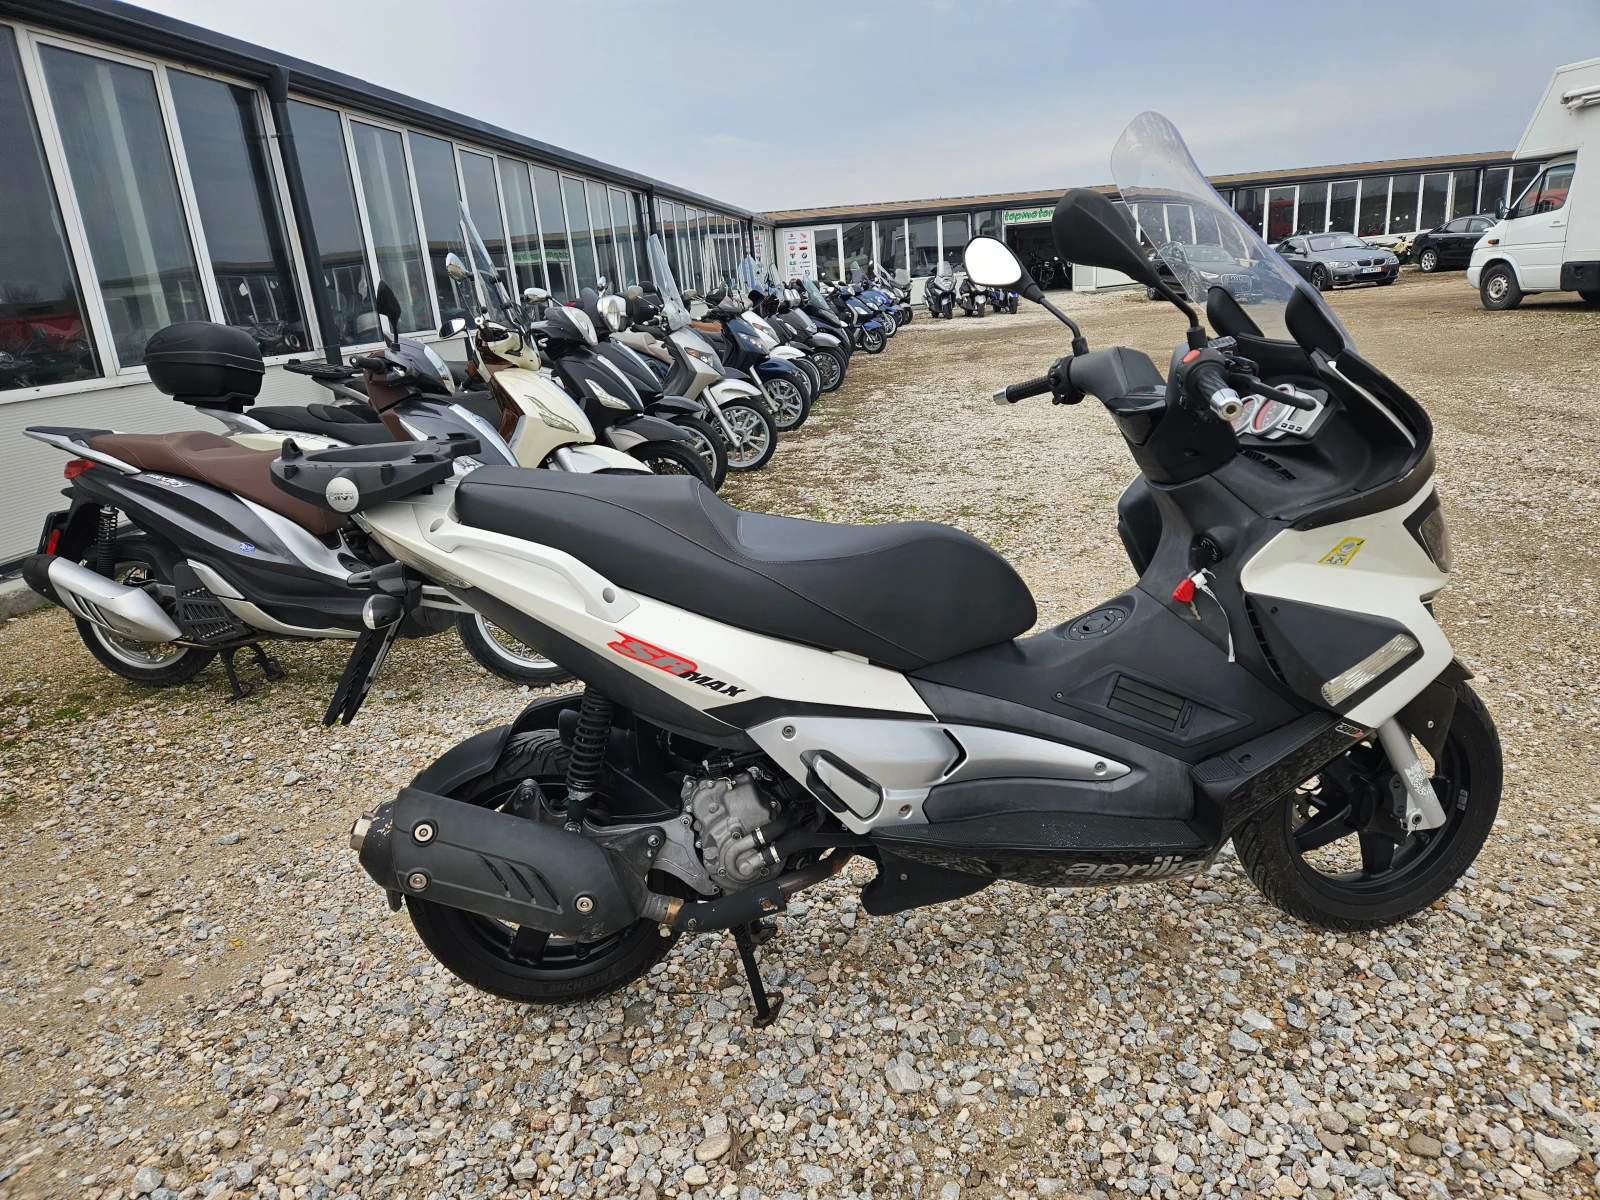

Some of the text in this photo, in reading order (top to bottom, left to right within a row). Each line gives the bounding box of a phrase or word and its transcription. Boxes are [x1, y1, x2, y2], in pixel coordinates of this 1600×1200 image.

[606, 629, 699, 678] SR
[677, 670, 747, 698] MAX
[1065, 855, 1207, 879] aprilia
[549, 972, 609, 992] MICHELIN
